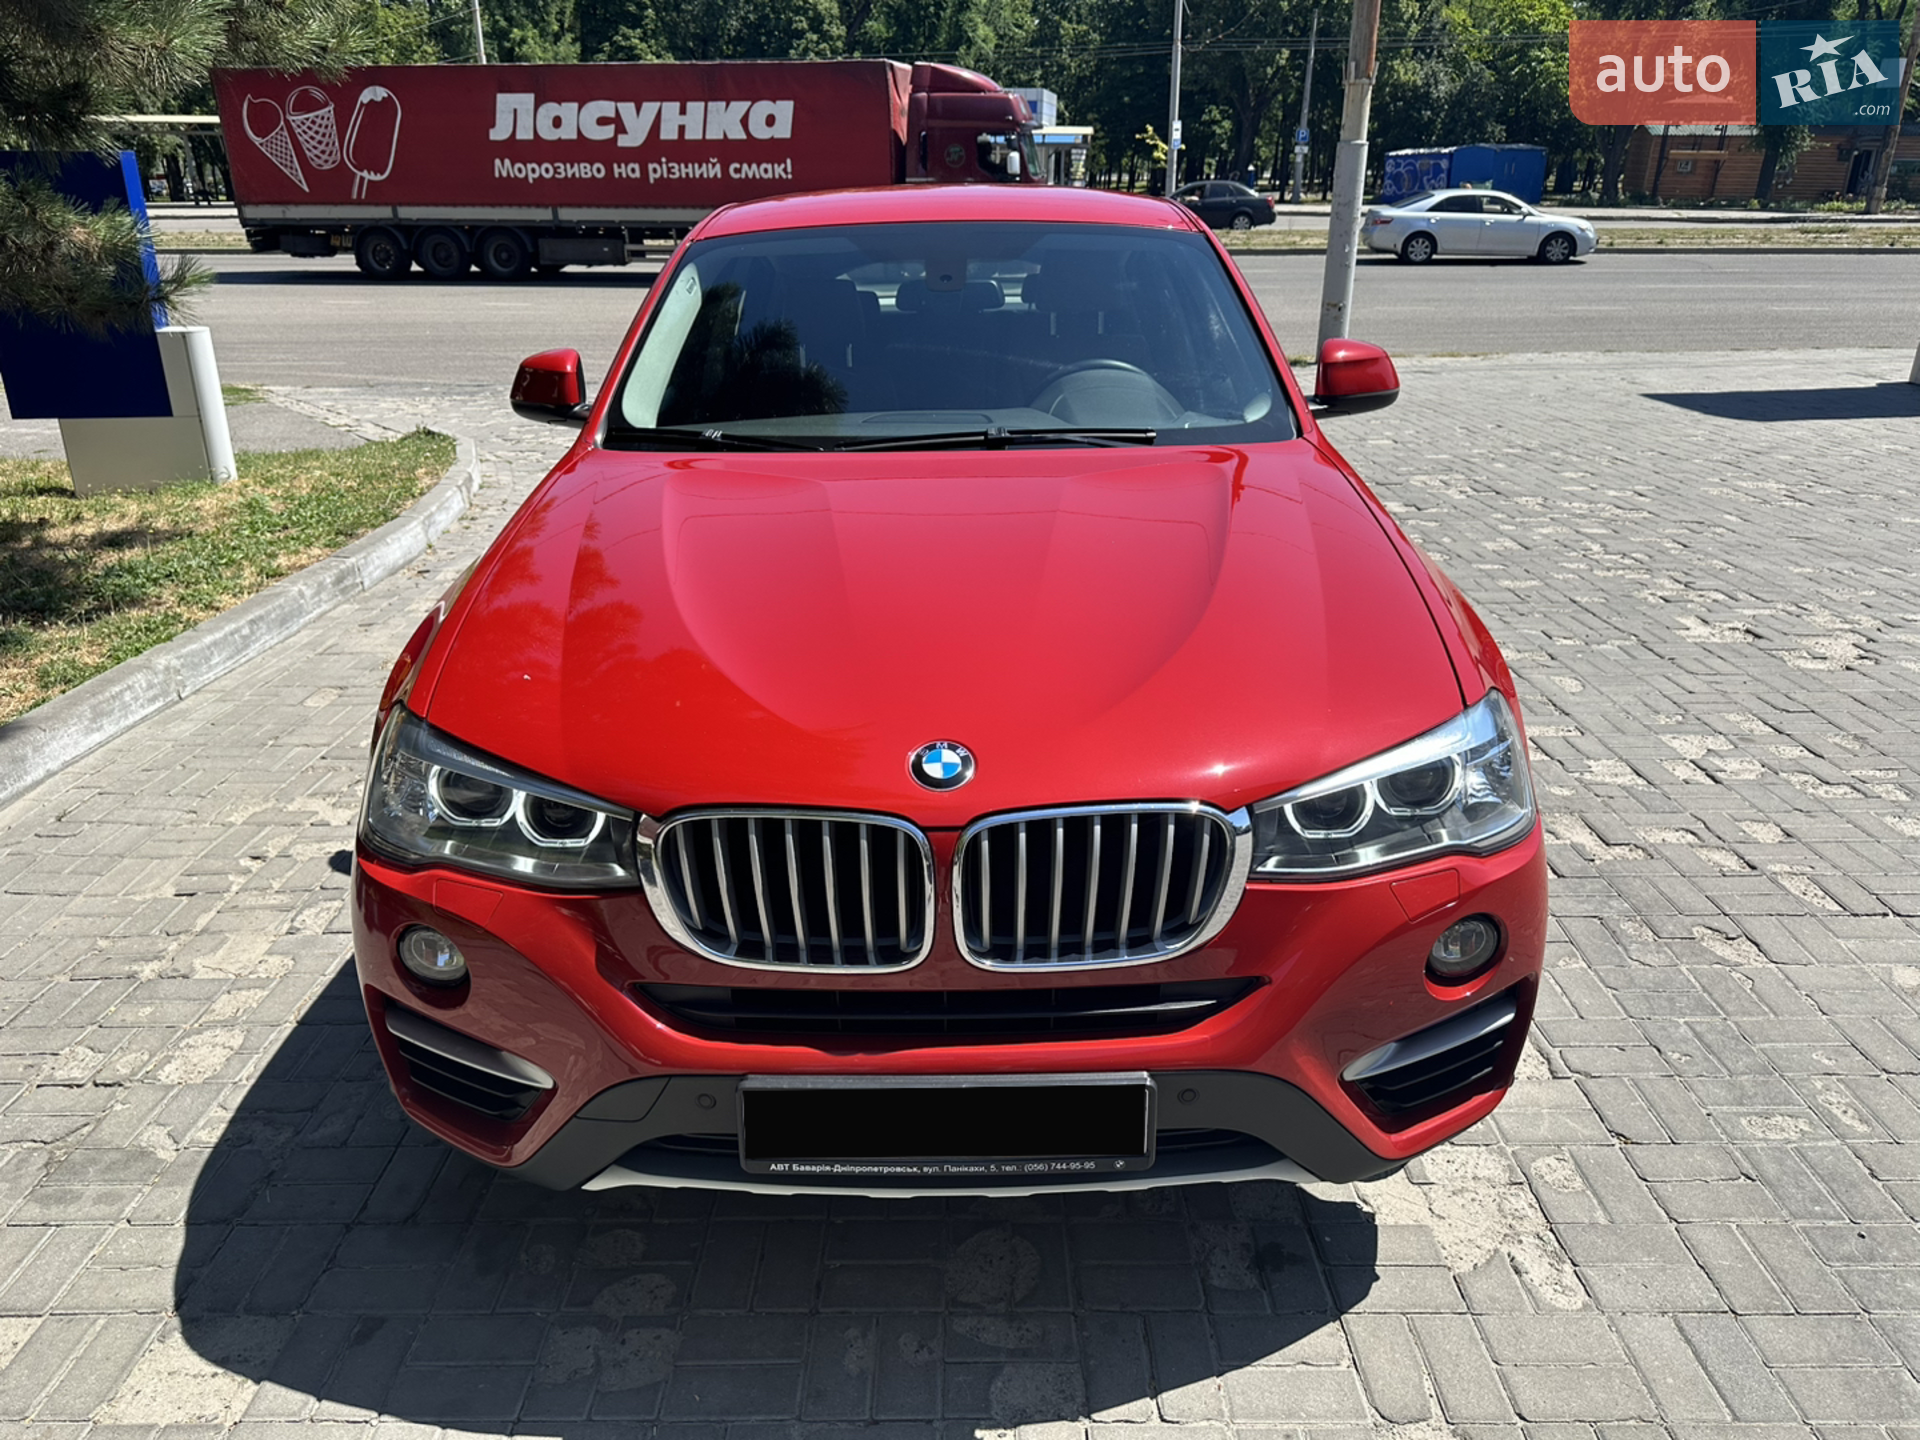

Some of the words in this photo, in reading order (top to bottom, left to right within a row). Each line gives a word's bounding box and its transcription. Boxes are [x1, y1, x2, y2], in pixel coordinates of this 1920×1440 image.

[489, 92, 795, 148] Ласунка
[494, 158, 606, 184] Морозиво
[613, 162, 641, 179] на
[648, 157, 721, 184] різний
[728, 158, 793, 179] смак!
[918, 741, 969, 756] BMW
[769, 1163, 790, 1172] АВТ
[792, 1163, 921, 1174] Баварія-Дніпропетровськ,
[923, 1166, 941, 1174] вул.
[943, 1164, 988, 1173] Панікахи,
[1024, 1163, 1049, 1173] (056)
[1050, 1161, 1096, 1171] 744-95-95
